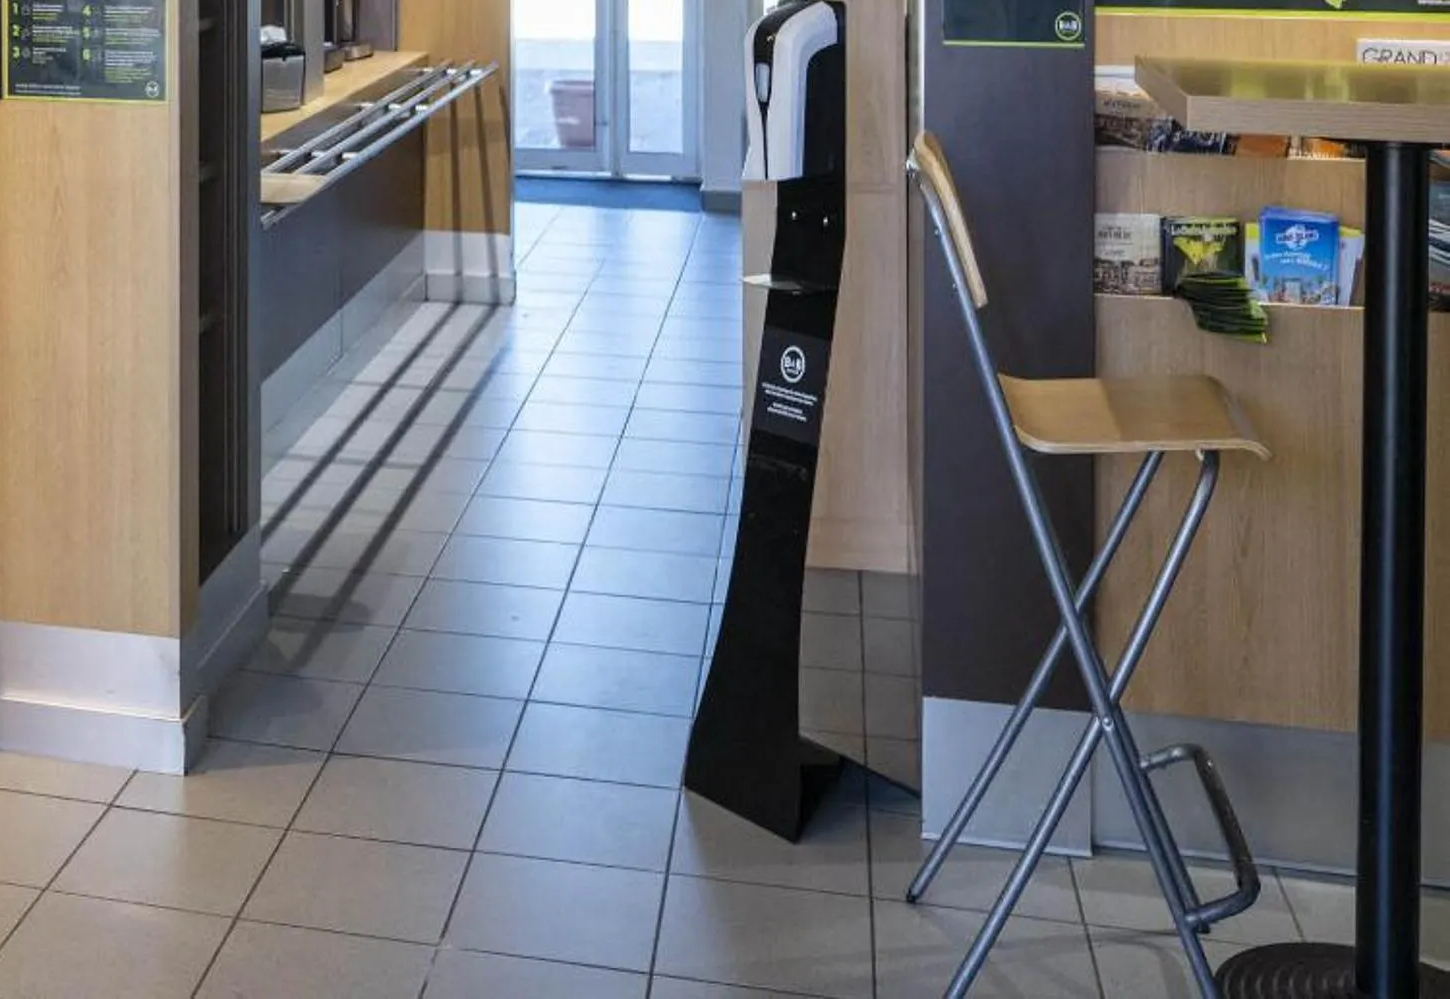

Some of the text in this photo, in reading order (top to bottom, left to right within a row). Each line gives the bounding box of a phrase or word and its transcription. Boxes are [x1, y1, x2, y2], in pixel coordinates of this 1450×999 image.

[12, 3, 19, 15] 1
[82, 5, 92, 16] 4
[12, 24, 21, 37] 2
[12, 47, 21, 59] 3
[1362, 47, 1438, 66] GRAND
